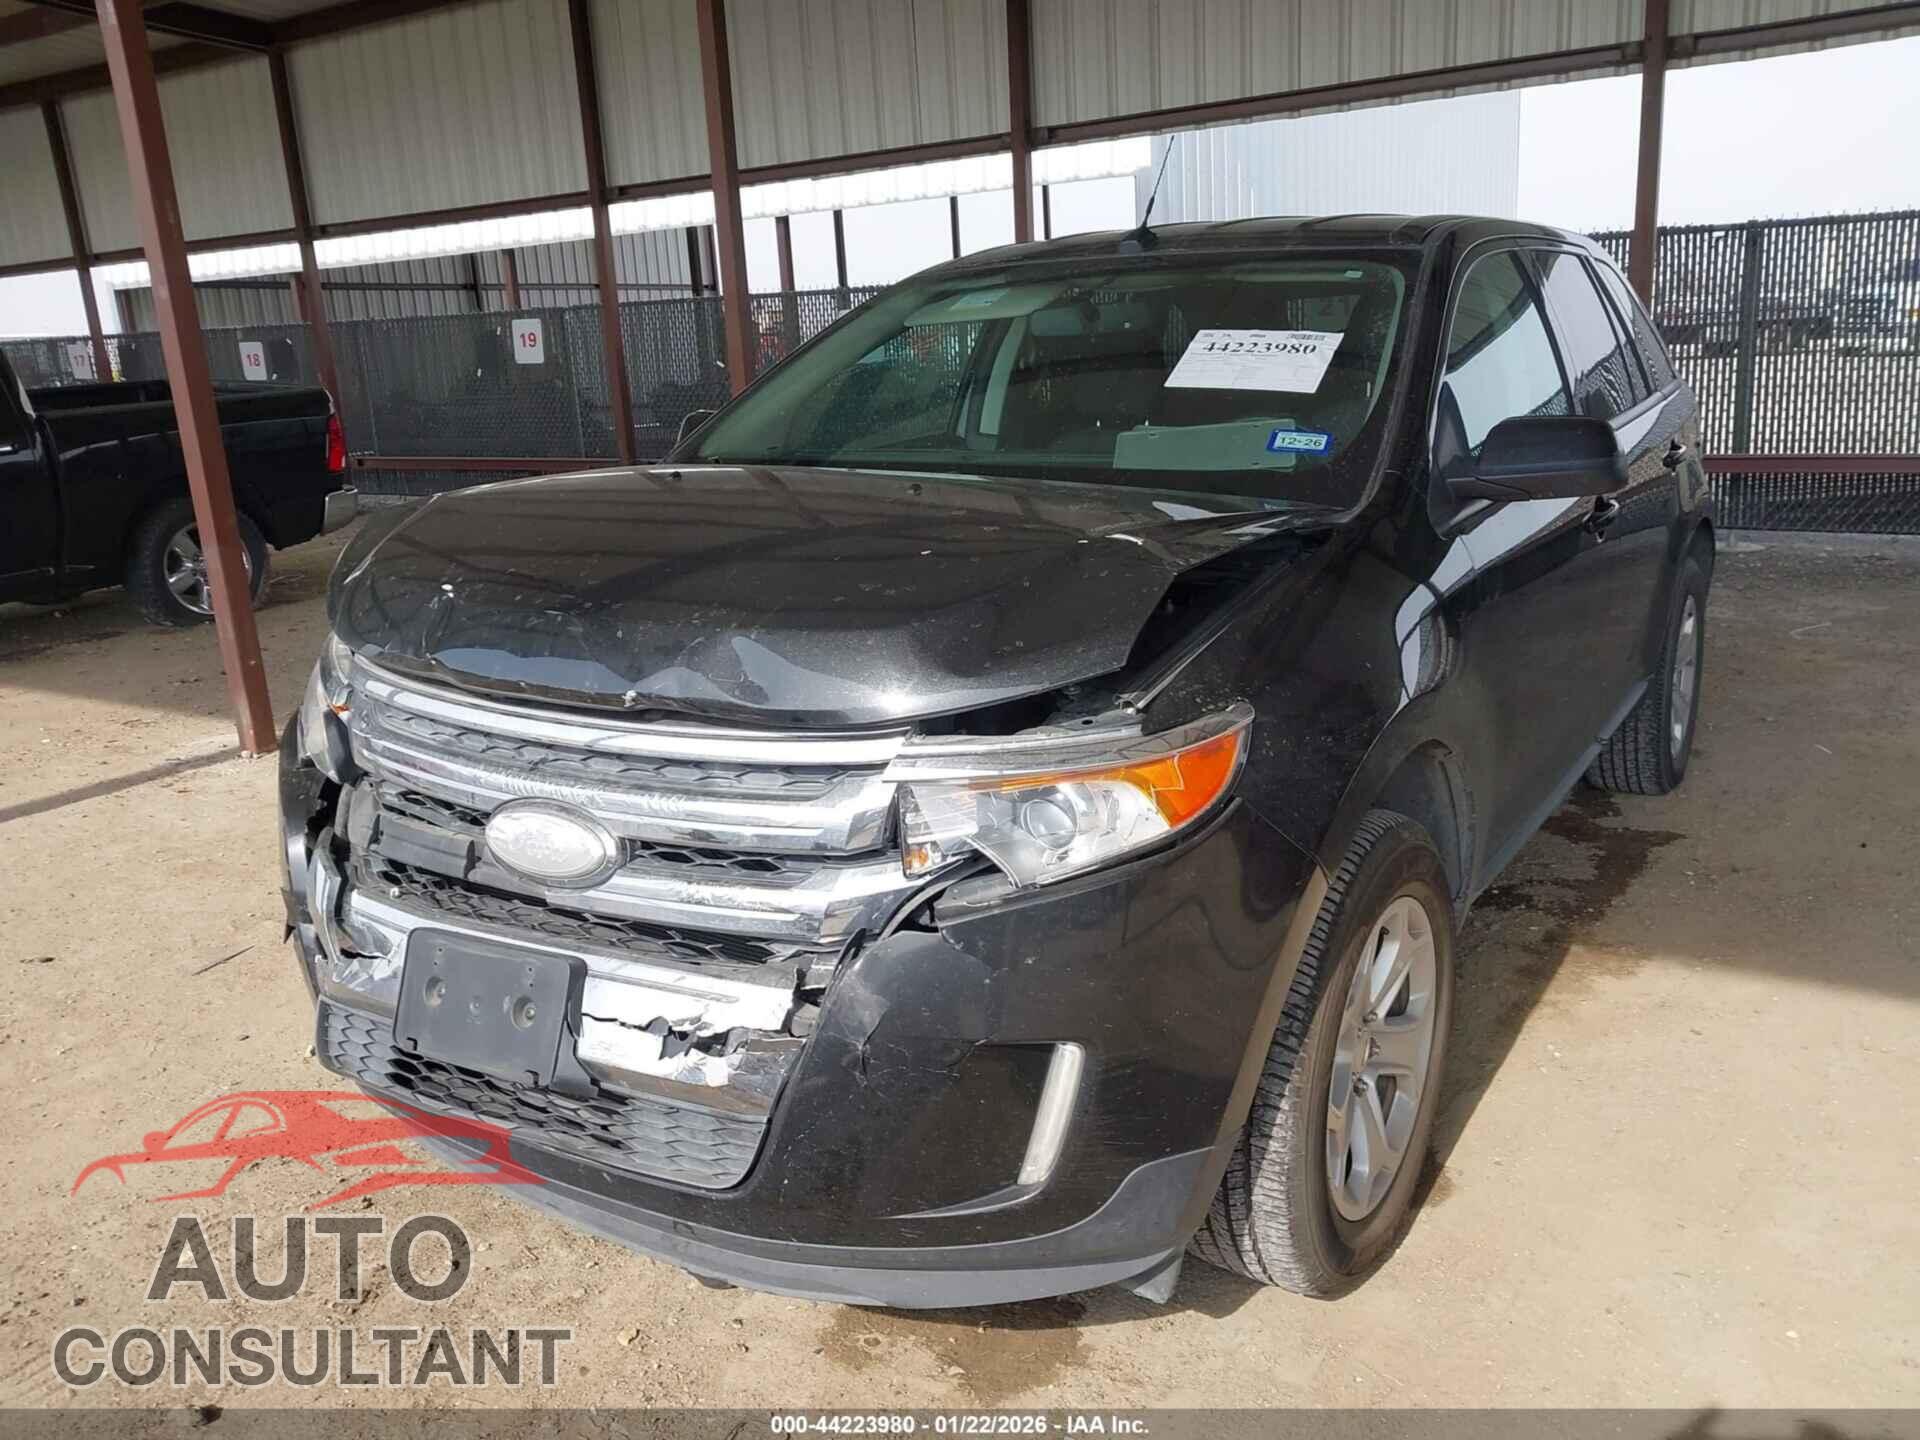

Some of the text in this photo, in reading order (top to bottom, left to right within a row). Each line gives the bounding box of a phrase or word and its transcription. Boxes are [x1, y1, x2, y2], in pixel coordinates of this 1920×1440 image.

[519, 332, 537, 348] 19
[1202, 341, 1317, 356] 44223980
[73, 354, 85, 368] 17
[246, 353, 261, 367] 18
[1280, 437, 1322, 447] 12-26
